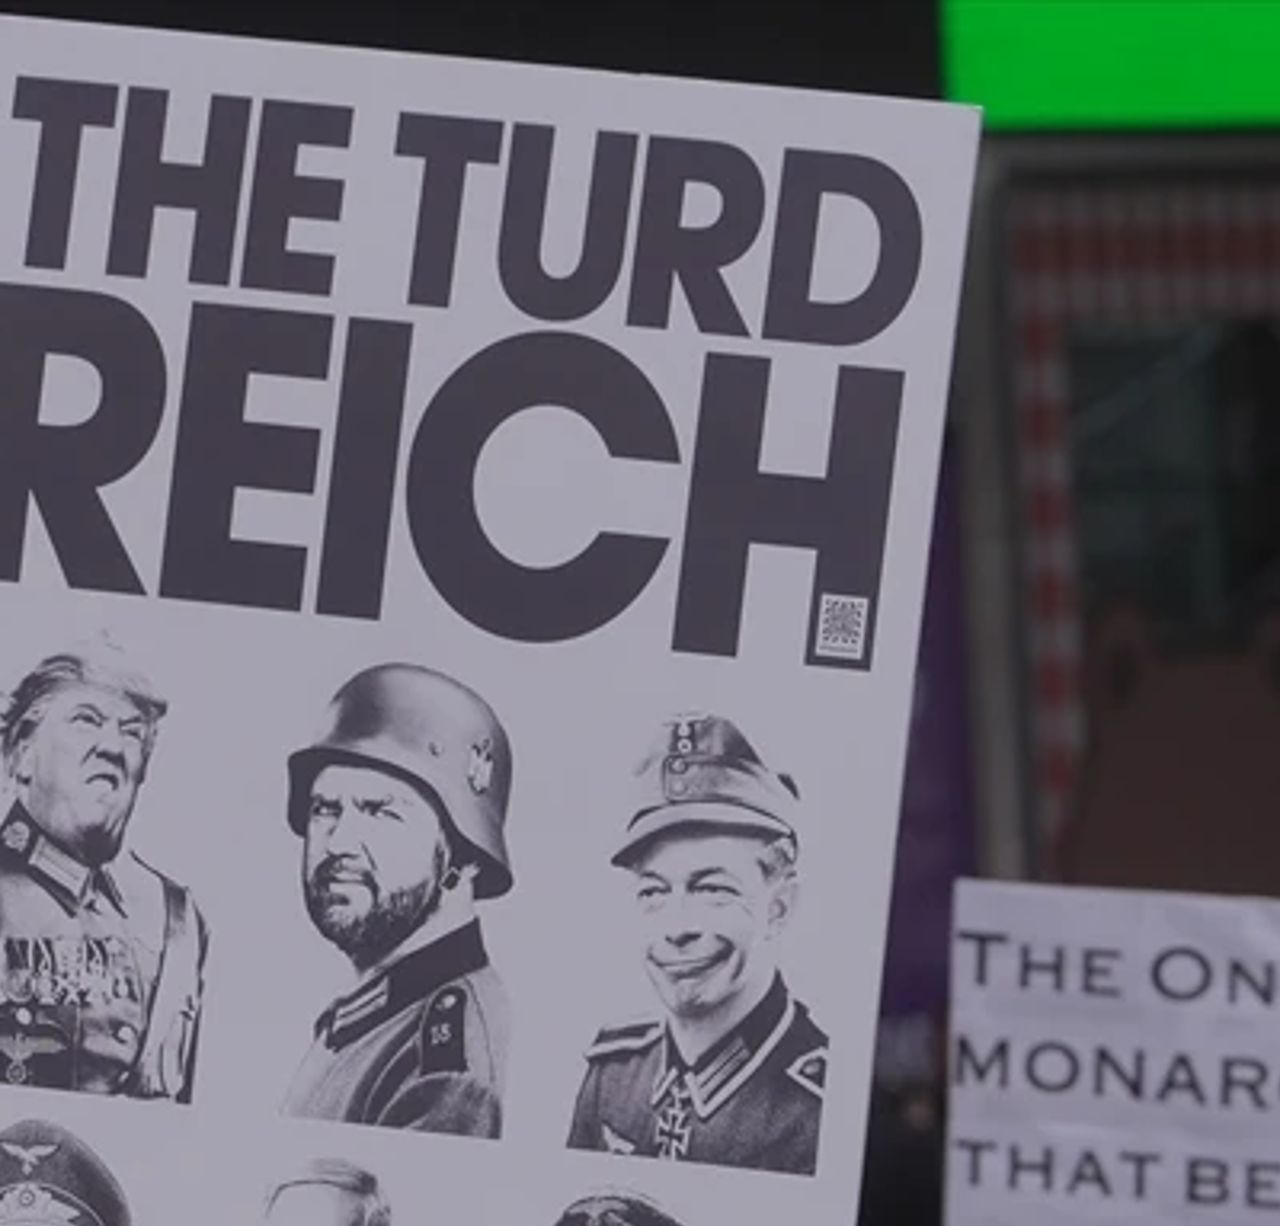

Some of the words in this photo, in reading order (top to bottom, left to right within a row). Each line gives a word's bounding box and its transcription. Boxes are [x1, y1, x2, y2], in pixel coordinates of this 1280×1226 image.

[12, 76, 355, 297] THE
[394, 111, 924, 347] TURD
[956, 930, 1122, 999] THE
[955, 1138, 1161, 1200] THAT
